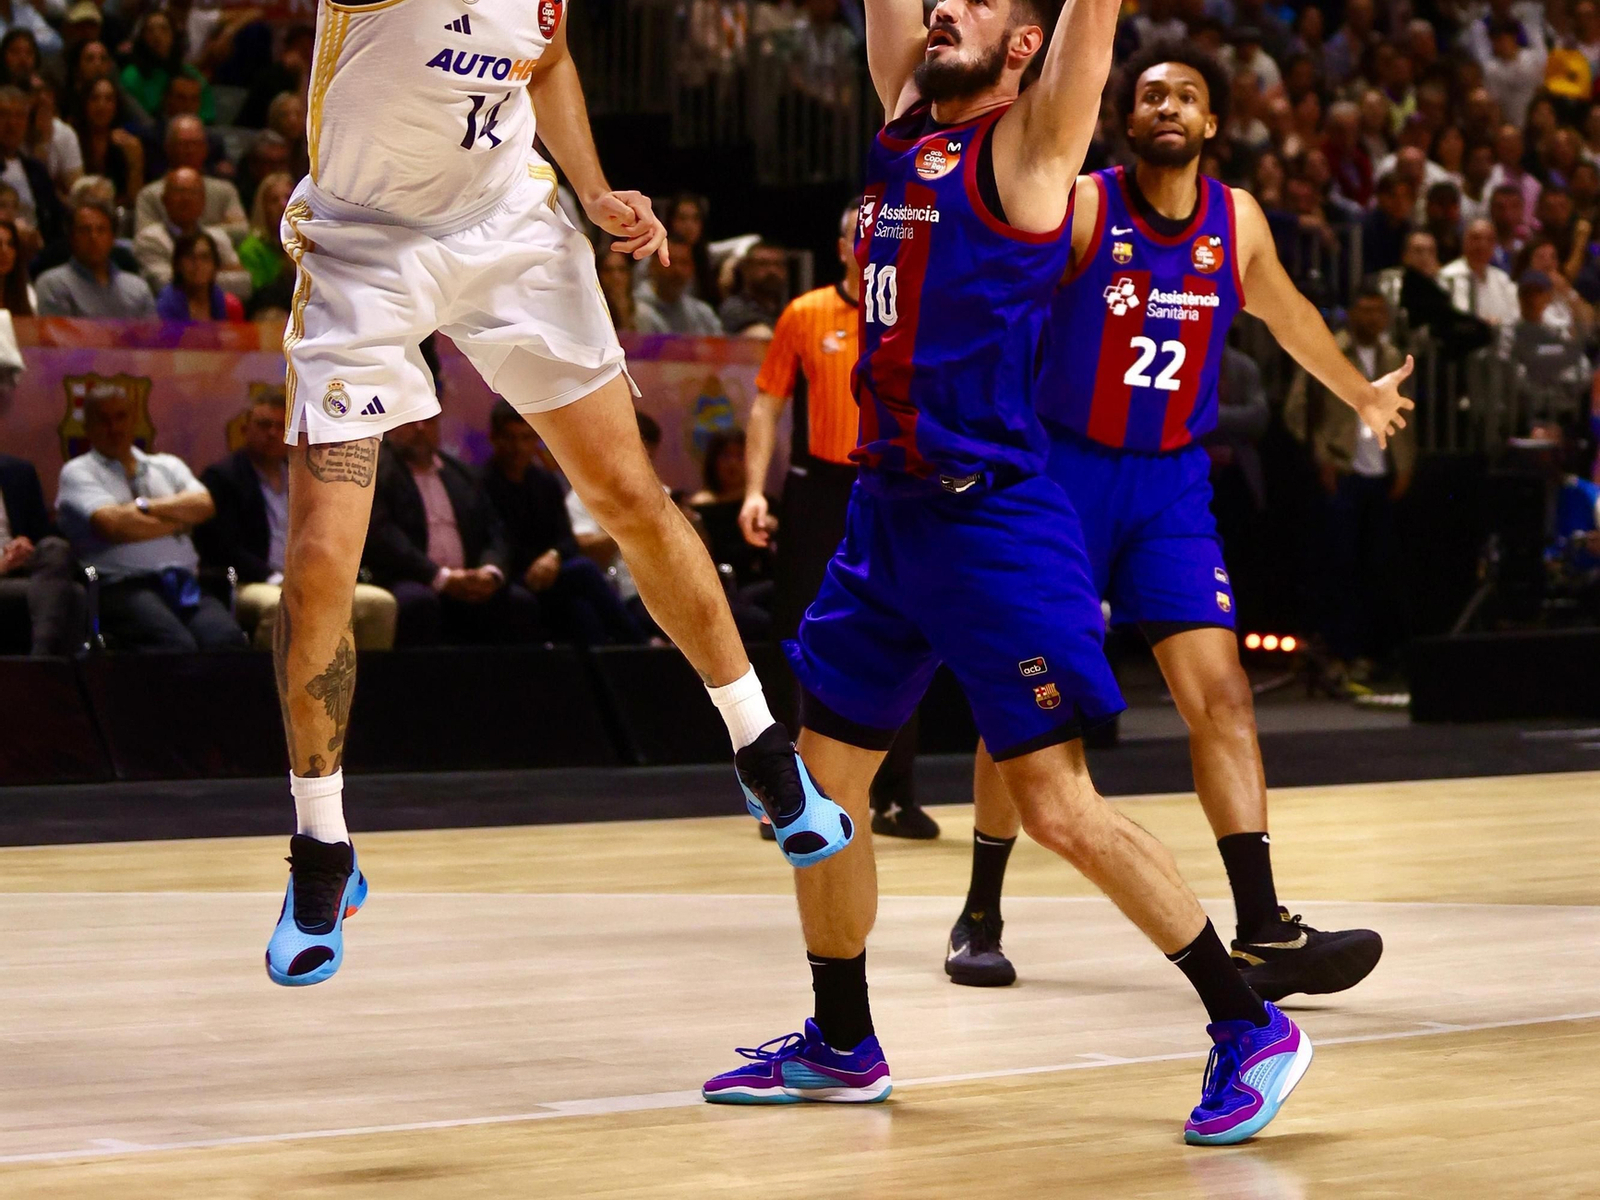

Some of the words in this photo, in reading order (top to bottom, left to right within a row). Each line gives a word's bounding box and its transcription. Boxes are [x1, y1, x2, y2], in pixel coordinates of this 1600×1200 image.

[924, 153, 946, 164] Copa
[878, 203, 940, 223] Assistència
[874, 220, 914, 240] Sanitària
[863, 263, 898, 327] 10
[1148, 288, 1220, 307] Assistència
[1146, 303, 1200, 321] Sanitària
[1123, 336, 1187, 391] 22
[1024, 665, 1041, 674] acb
